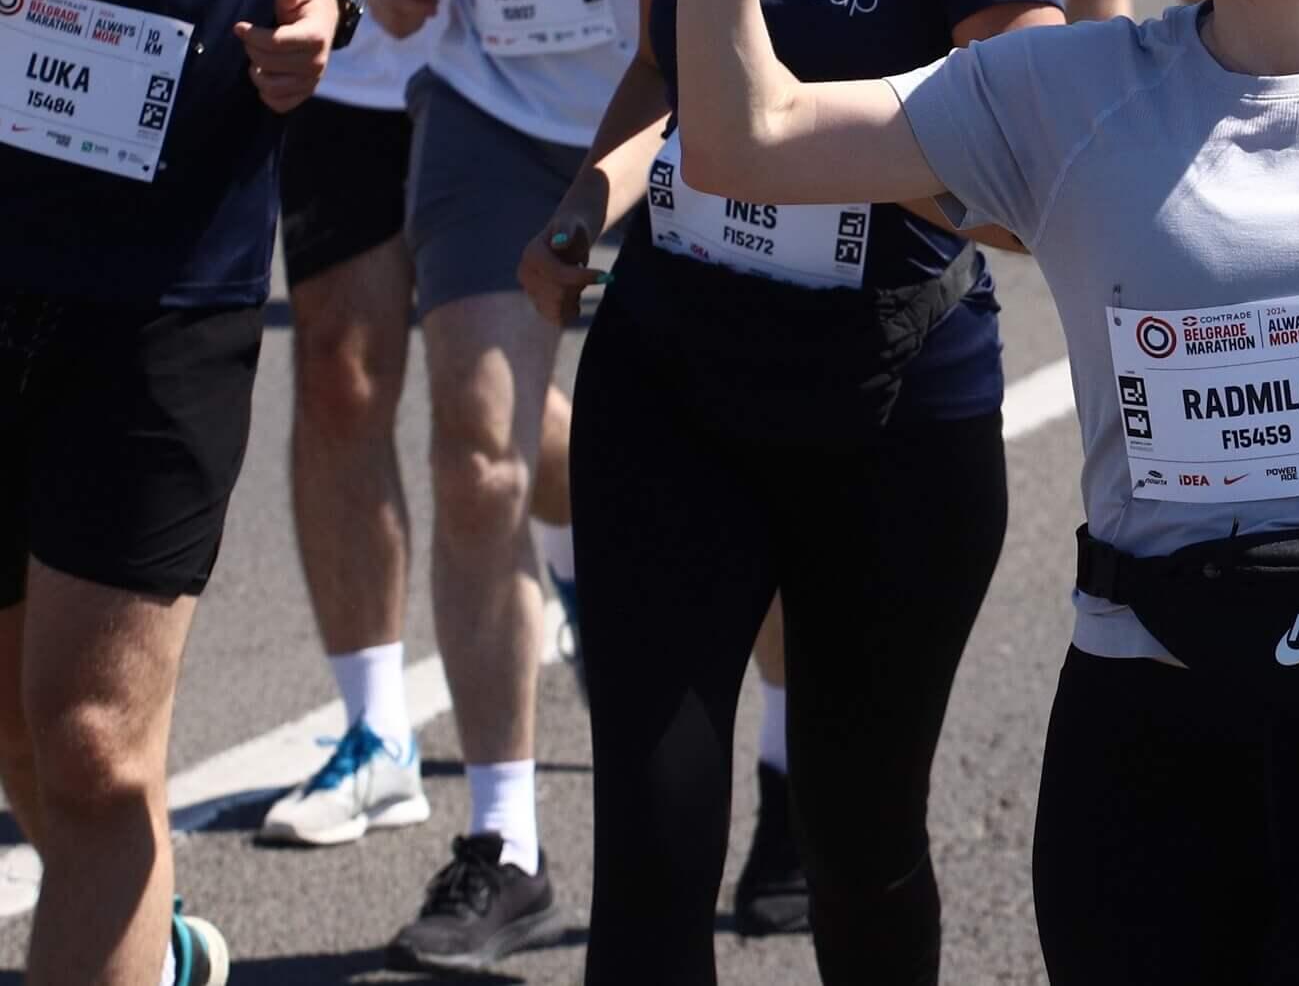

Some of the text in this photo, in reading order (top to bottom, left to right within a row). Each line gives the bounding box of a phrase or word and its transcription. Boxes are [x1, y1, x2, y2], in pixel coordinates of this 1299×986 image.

[25, 11, 83, 36] MARATHON
[95, 18, 137, 38] ALWAYS
[148, 29, 161, 42] 10
[144, 43, 163, 57] KM
[26, 52, 91, 94] LUKA
[27, 90, 75, 118] 15484
[724, 198, 778, 230] INES
[722, 226, 775, 256] F15272
[1199, 311, 1252, 324] COMTRADE
[1184, 322, 1247, 342] BELGRADE
[1185, 335, 1256, 356] MARATHON
[1221, 424, 1293, 450] F15459
[1265, 466, 1298, 477] POWER
